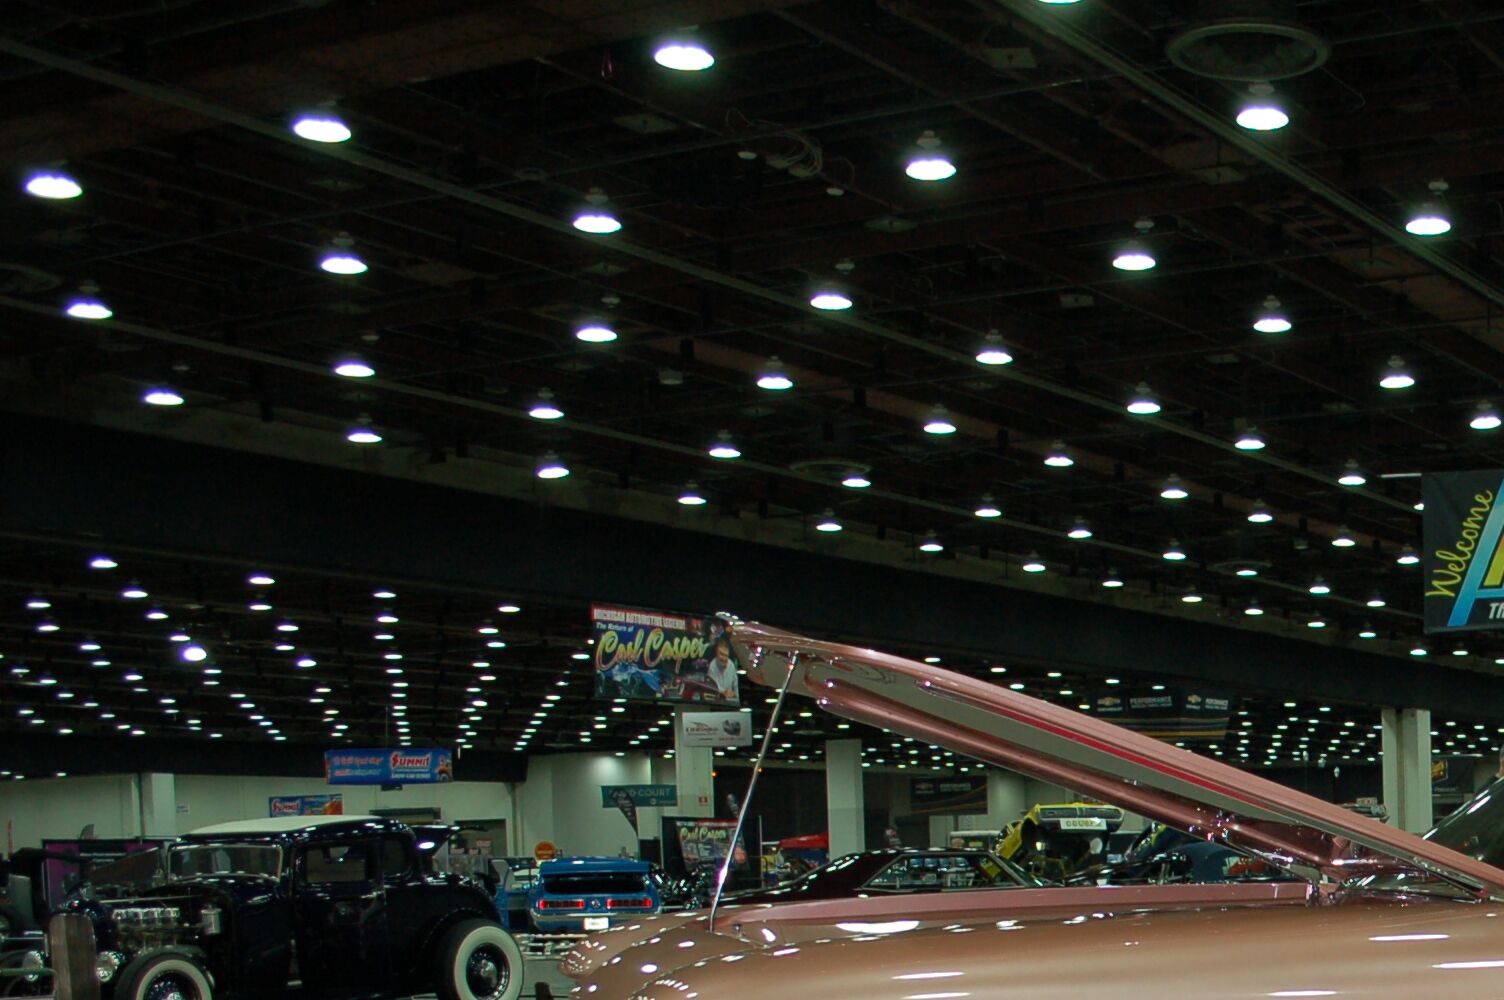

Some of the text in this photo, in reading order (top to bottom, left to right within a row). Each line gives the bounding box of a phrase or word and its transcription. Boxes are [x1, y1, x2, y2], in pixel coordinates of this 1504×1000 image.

[1425, 489, 1493, 597] Welcome
[596, 628, 708, 673] Carl Casper
[638, 789, 671, 797] COURT
